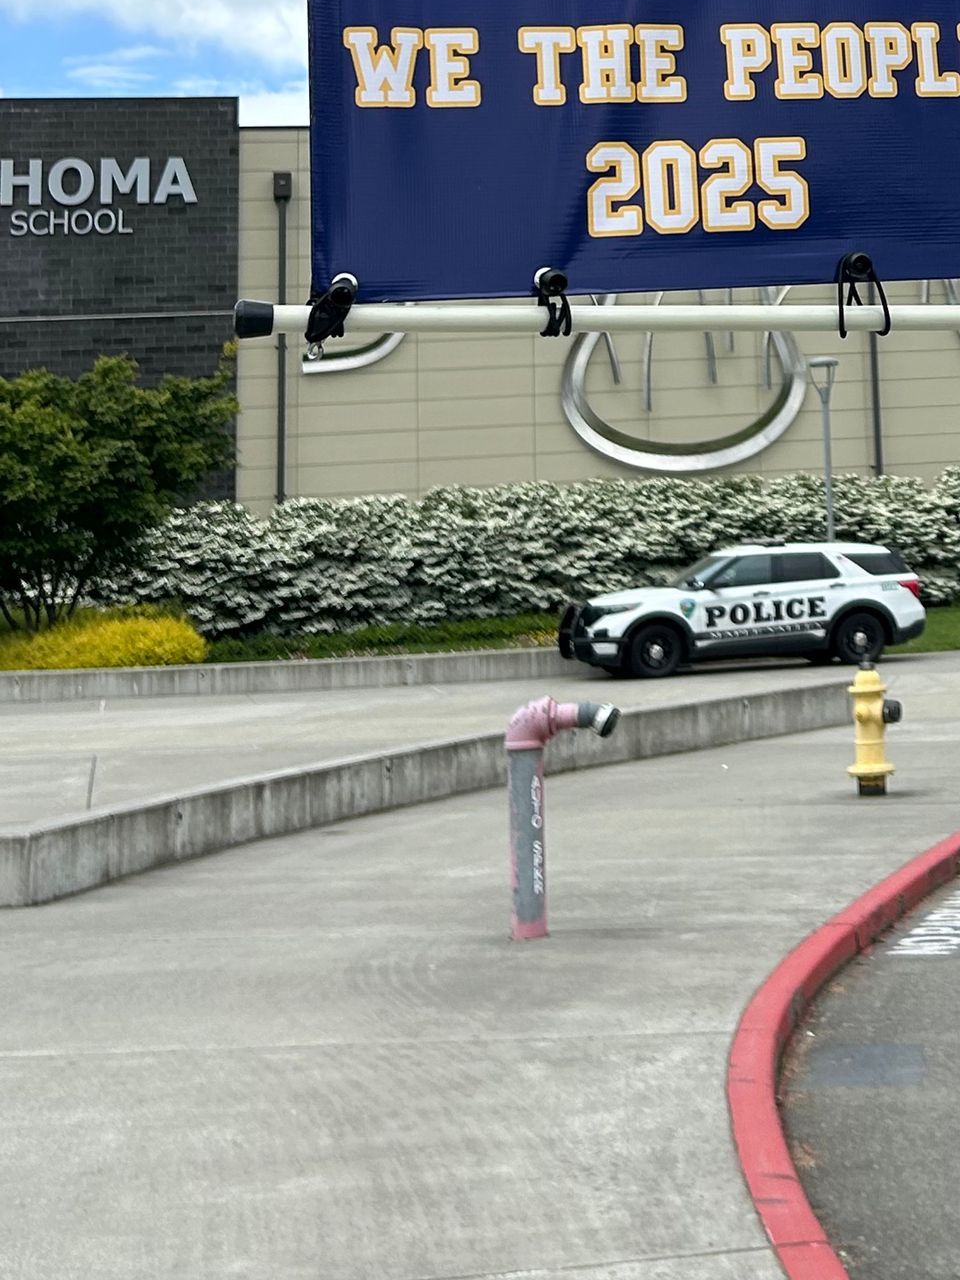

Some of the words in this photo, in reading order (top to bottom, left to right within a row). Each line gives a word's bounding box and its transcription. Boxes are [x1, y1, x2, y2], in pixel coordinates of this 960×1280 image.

[342, 26, 482, 108] WE
[517, 23, 688, 106] THE
[0, 157, 198, 206] HOMA
[585, 136, 810, 238] 2025
[10, 209, 133, 236] SCHOOL
[705, 596, 827, 628] POLICE
